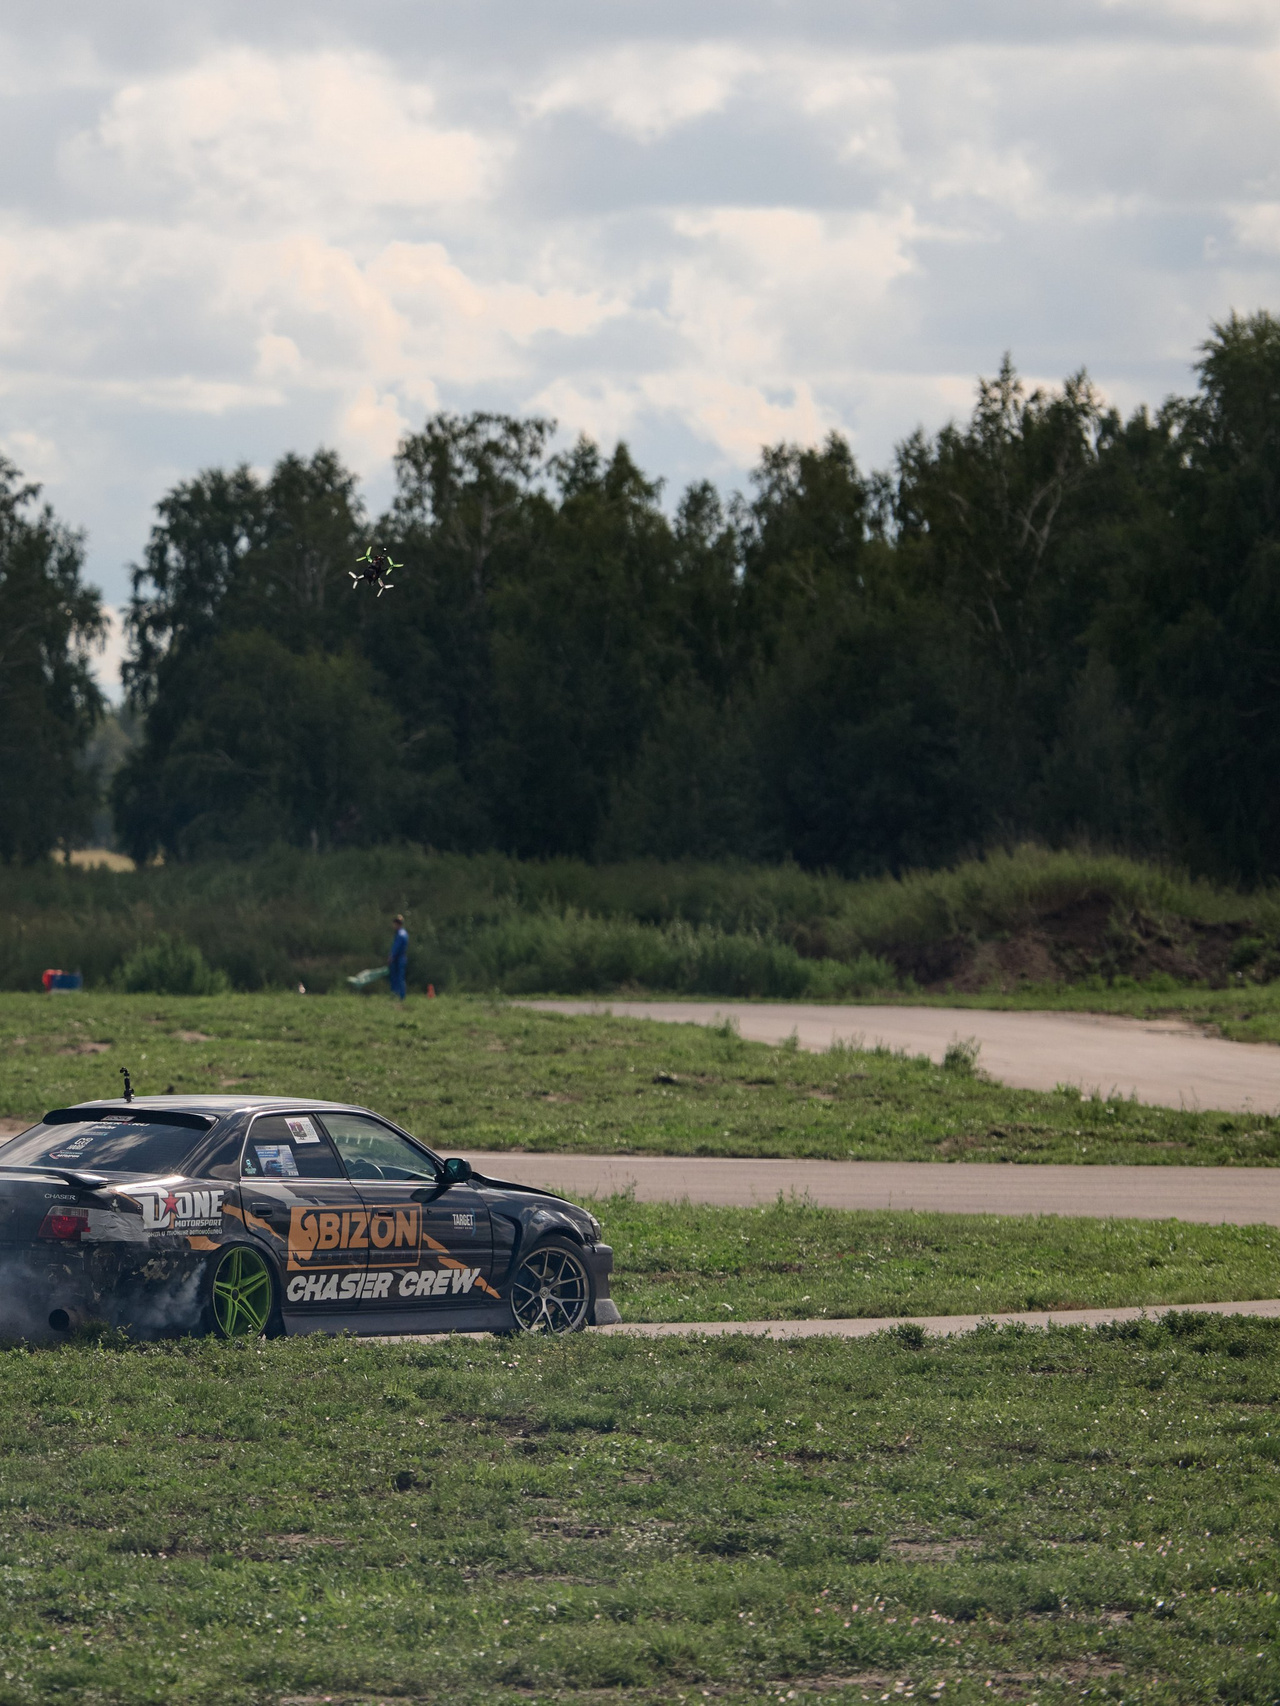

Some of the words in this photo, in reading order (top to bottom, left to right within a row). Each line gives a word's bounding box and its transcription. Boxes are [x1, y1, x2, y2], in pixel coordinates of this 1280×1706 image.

[44, 1193, 77, 1201] CHASER
[174, 1219, 223, 1228] MOTORSPORT
[452, 1213, 474, 1226] TARGET
[317, 1209, 418, 1250] BIZON
[286, 1271, 394, 1301] CHASER
[398, 1267, 481, 1297] CREW
